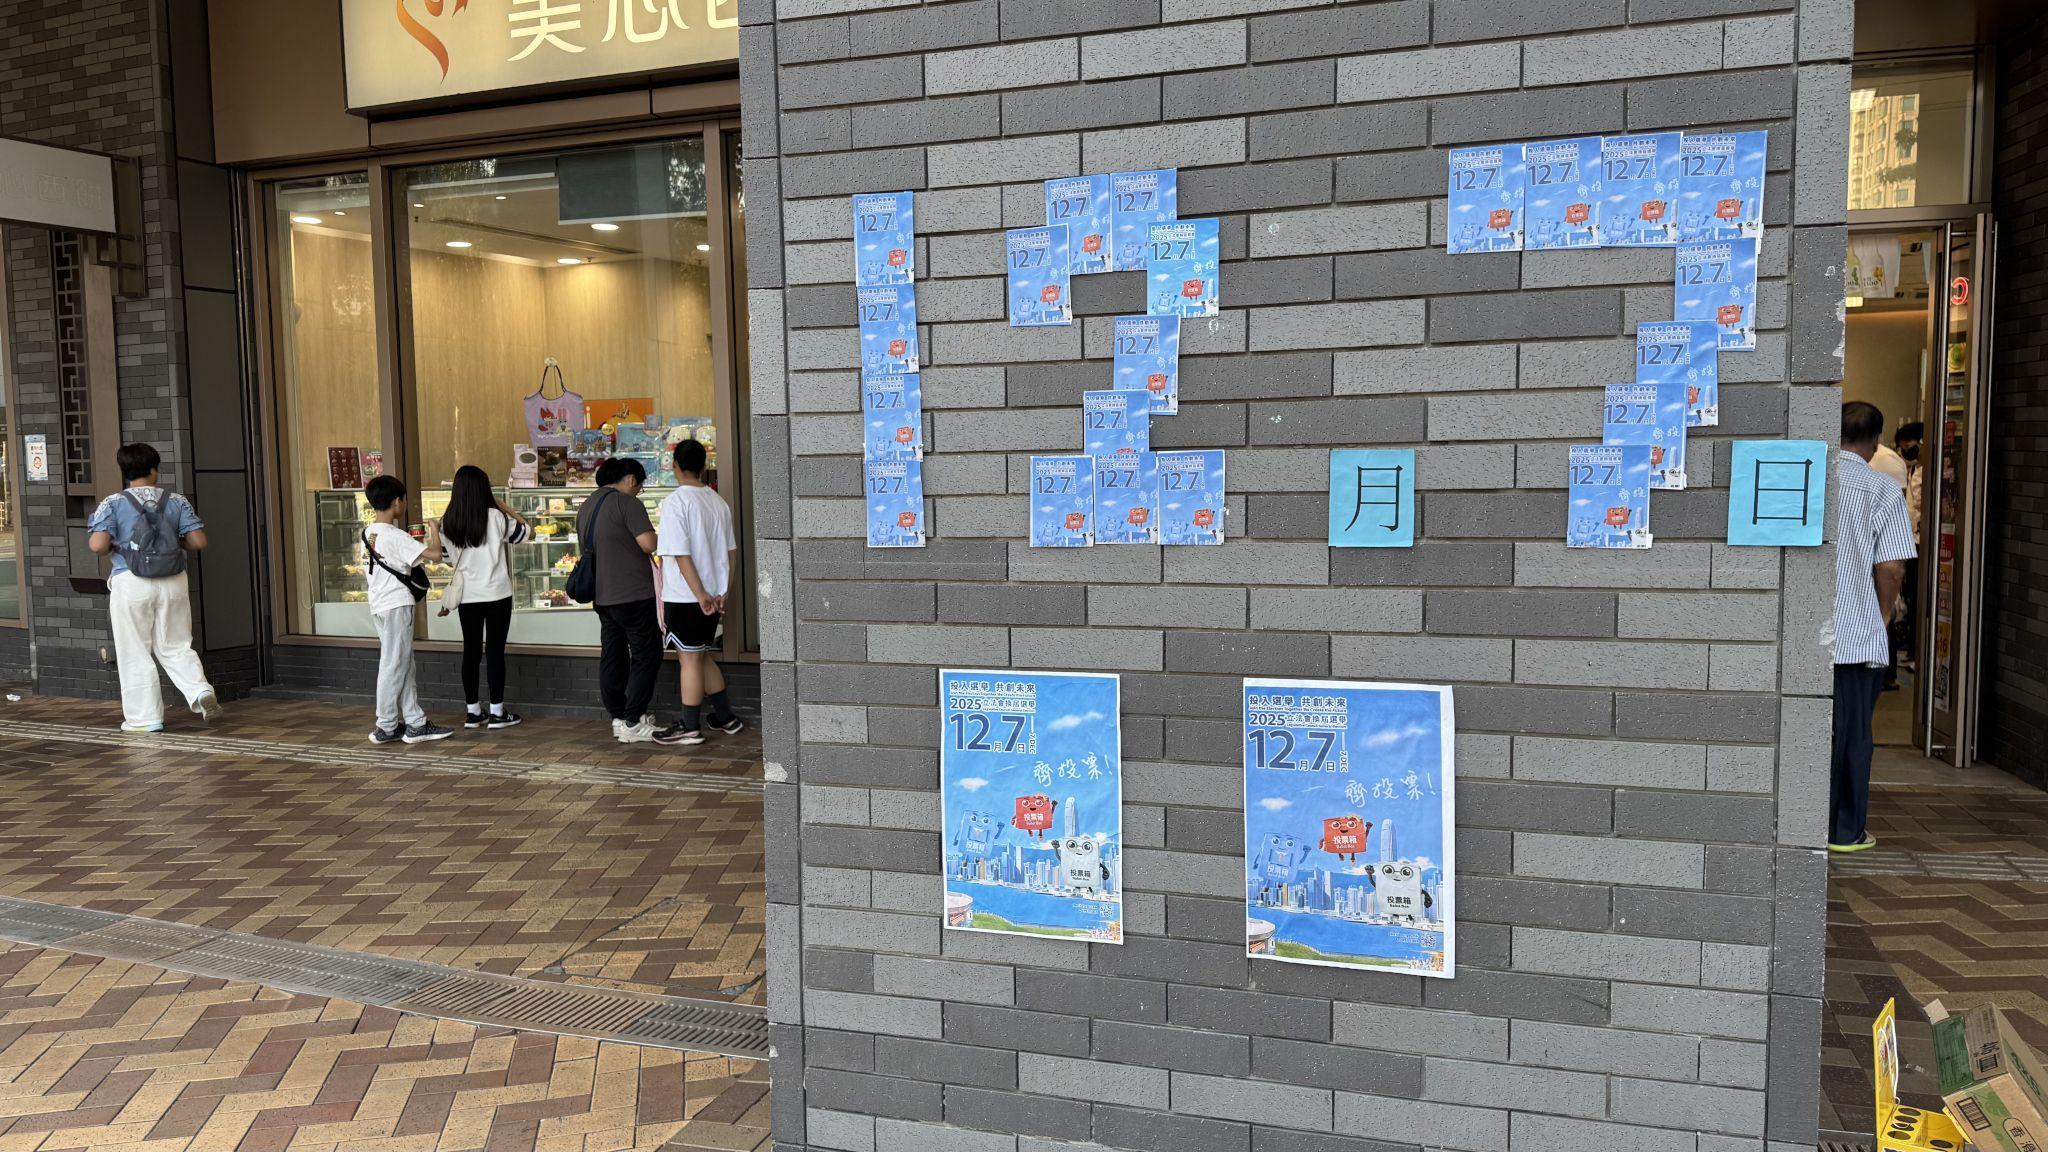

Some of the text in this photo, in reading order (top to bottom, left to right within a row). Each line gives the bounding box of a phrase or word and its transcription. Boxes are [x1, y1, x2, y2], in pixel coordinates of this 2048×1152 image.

[1752, 458, 1814, 526] 日
[1344, 465, 1403, 532] 月
[995, 683, 1035, 693] 共創未來
[1301, 697, 1346, 707] 共創未來
[1387, 896, 1412, 905] 投票箱
